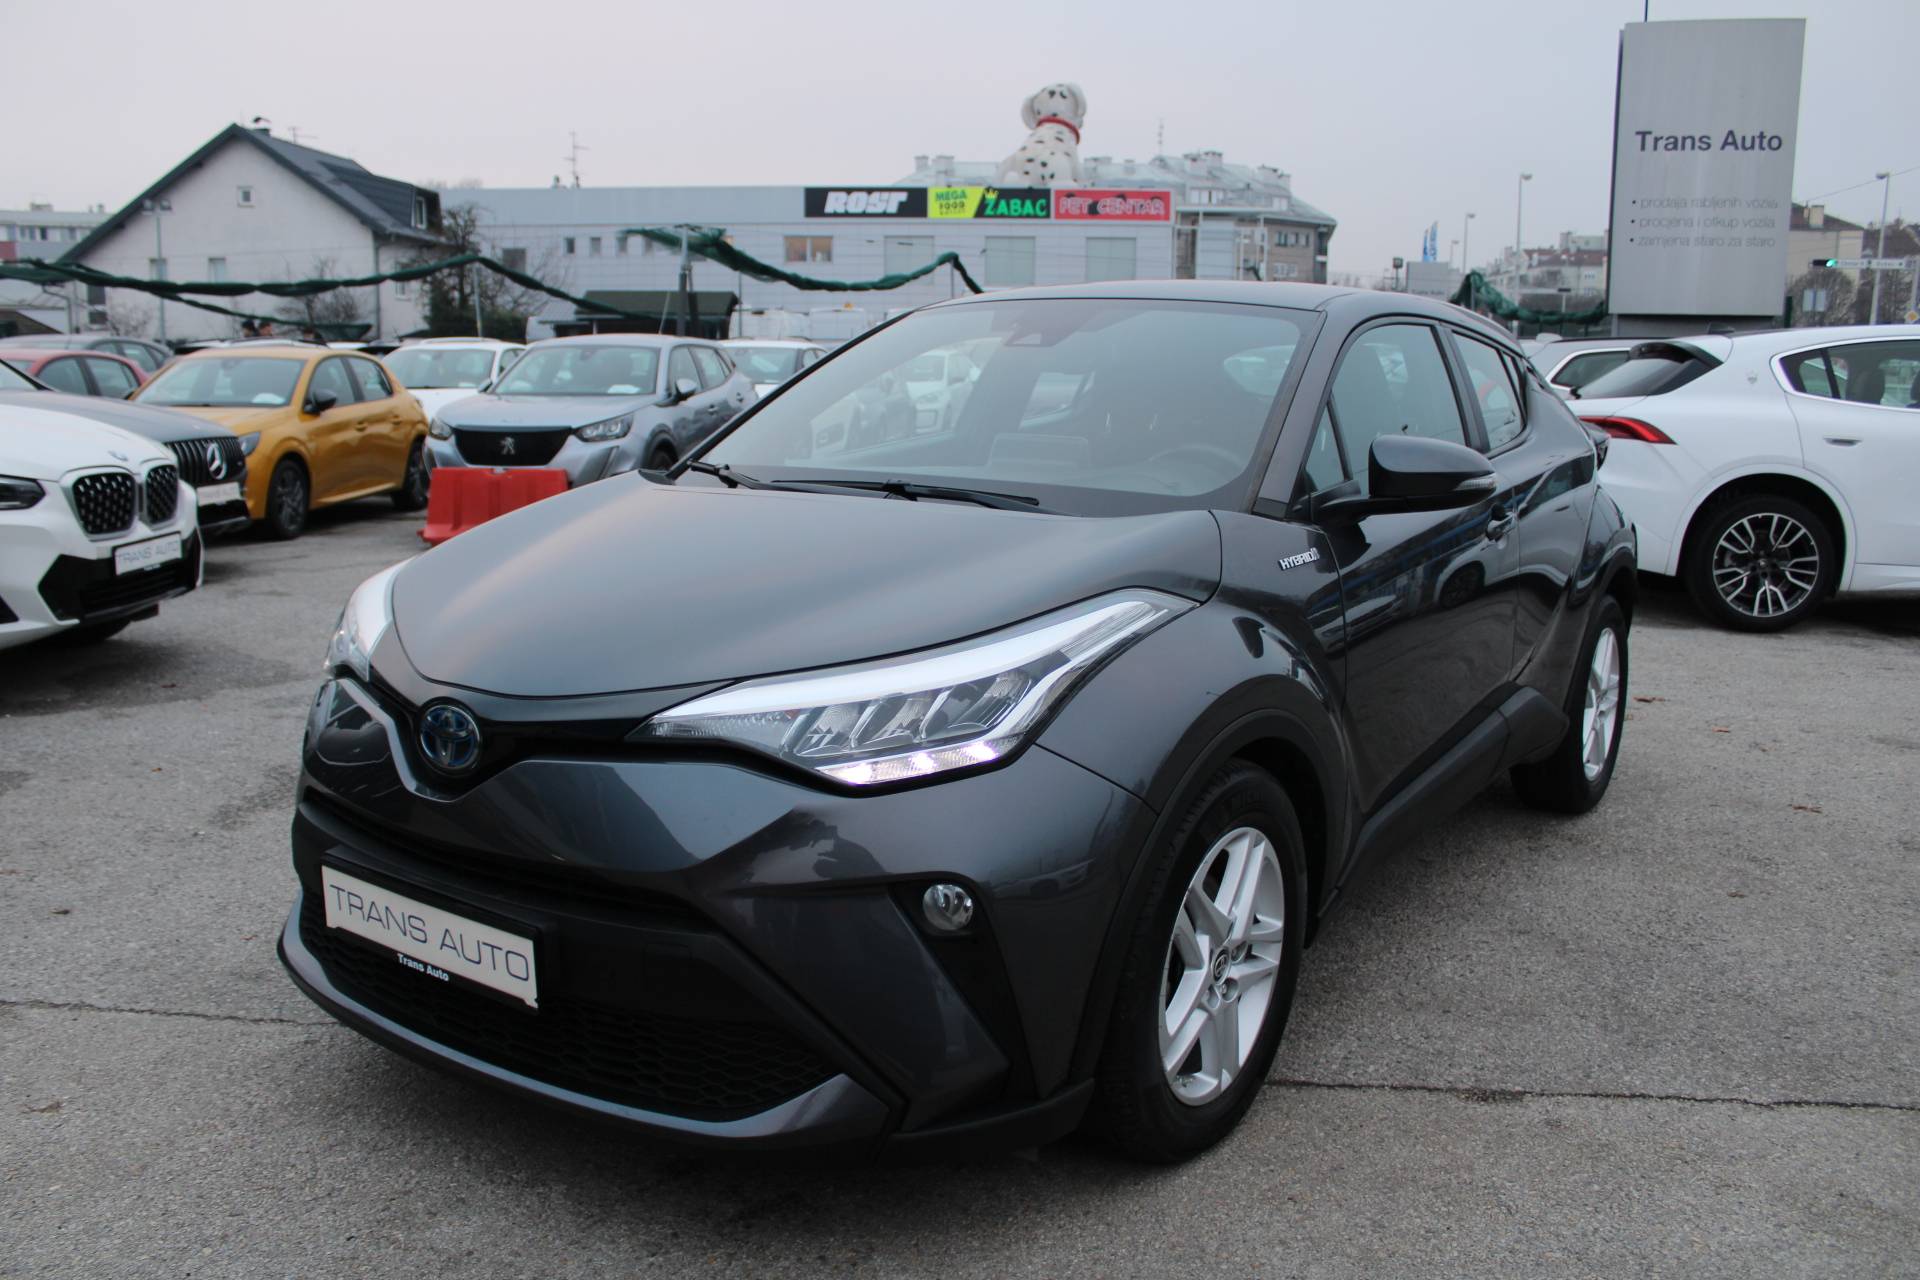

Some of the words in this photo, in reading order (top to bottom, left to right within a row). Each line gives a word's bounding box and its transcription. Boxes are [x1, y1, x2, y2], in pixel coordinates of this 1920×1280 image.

[1635, 131, 1712, 152] Trans
[1720, 130, 1783, 151] Auto
[935, 189, 967, 201] MEGA
[1640, 198, 1687, 210] prodaja
[1059, 196, 1092, 215] PET
[1097, 196, 1165, 215] CENTAR
[1694, 235, 1725, 248] staro
[1728, 237, 1742, 248] za
[1745, 235, 1776, 248] staro
[1279, 551, 1315, 570] HYBRID
[329, 884, 428, 944] TRANS
[440, 928, 530, 982] AUTO
[398, 953, 425, 973] Trans
[426, 964, 450, 982] Auto
